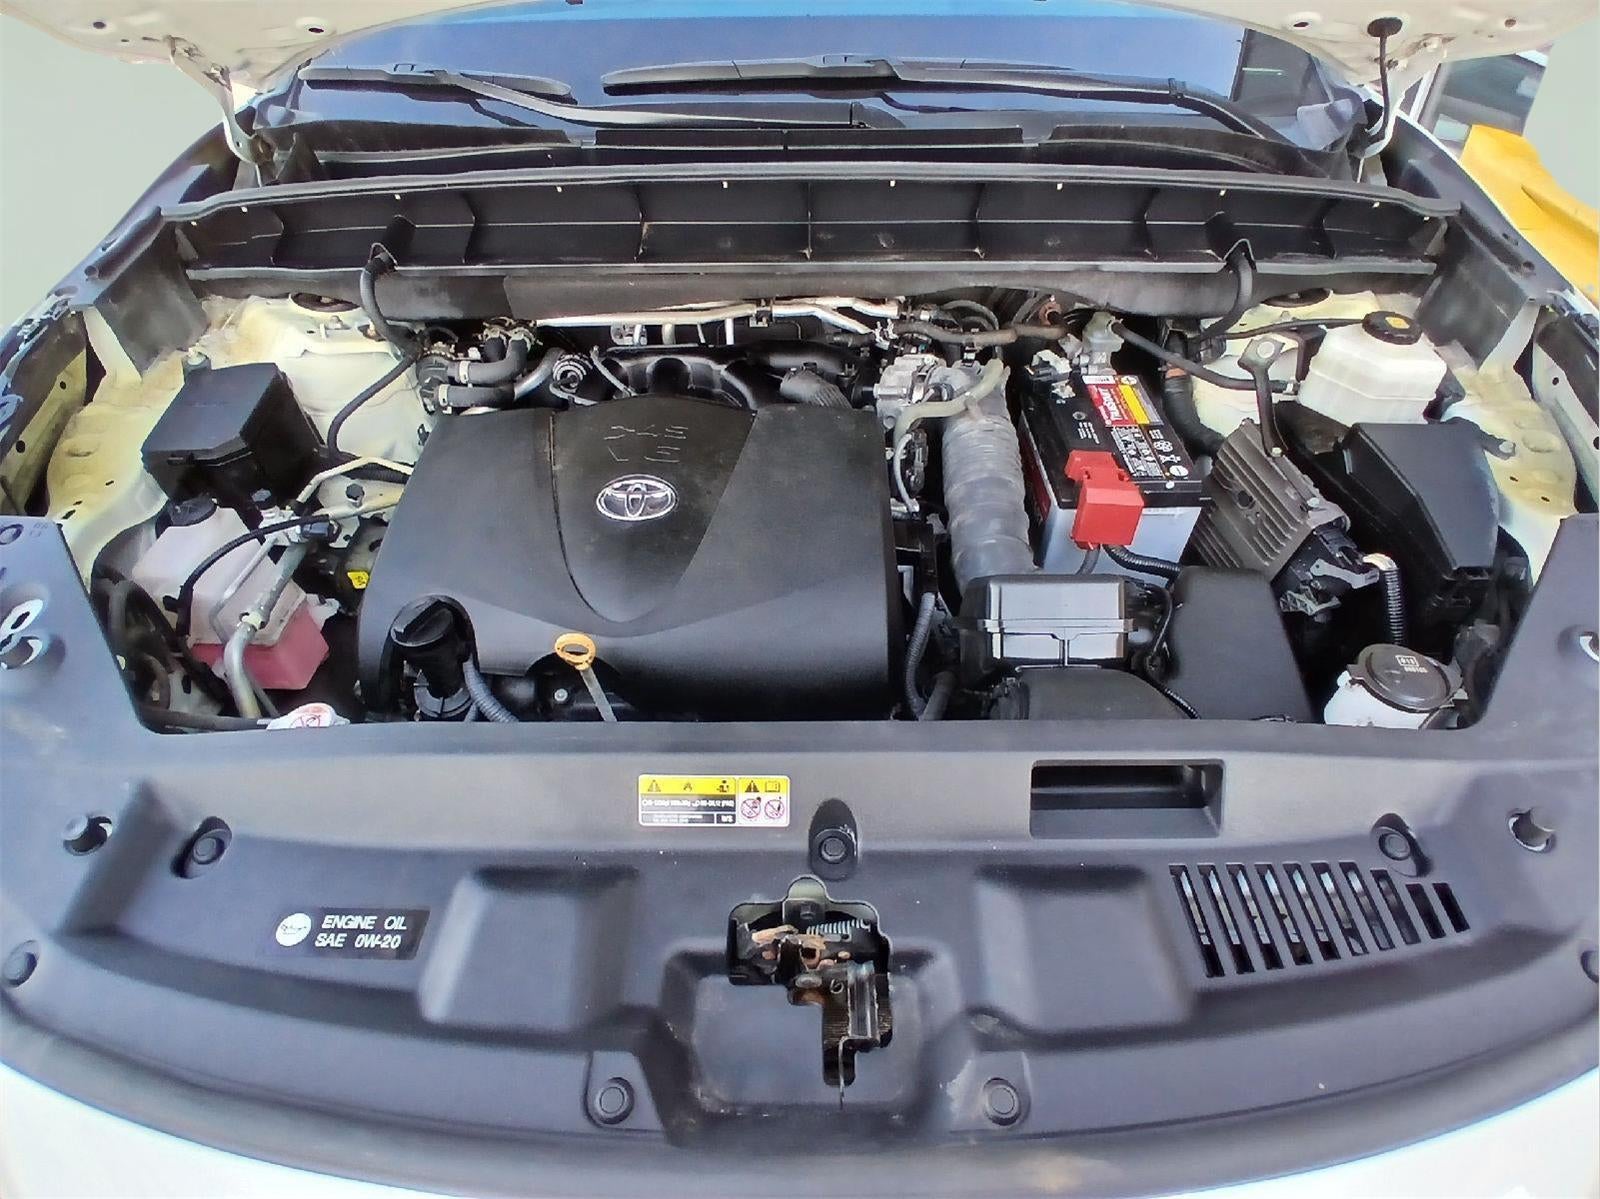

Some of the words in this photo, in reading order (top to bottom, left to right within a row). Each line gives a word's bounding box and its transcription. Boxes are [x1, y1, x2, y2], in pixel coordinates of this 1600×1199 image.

[322, 915, 377, 929] ENGINE
[384, 916, 407, 930] OIL
[315, 933, 347, 947] SAE
